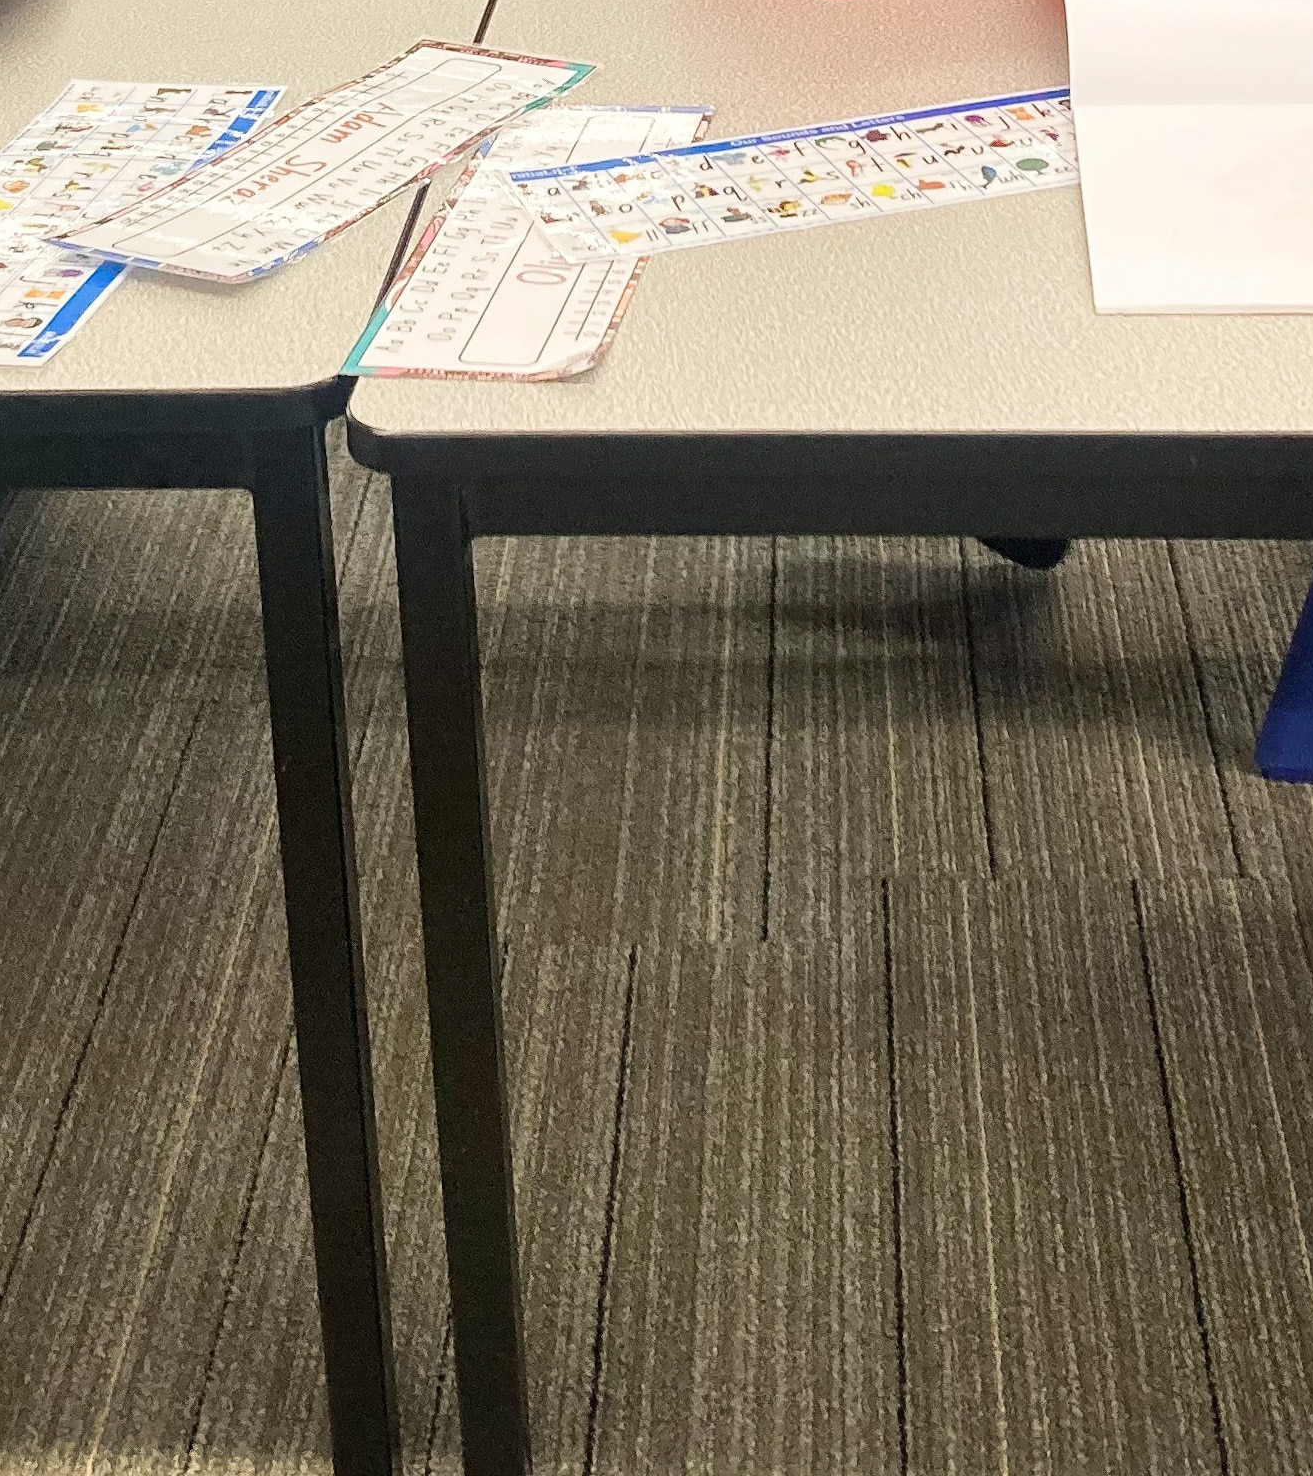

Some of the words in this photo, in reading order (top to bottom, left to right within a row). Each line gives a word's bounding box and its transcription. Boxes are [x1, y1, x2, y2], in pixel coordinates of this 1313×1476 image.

[319, 101, 404, 144] Adam
[761, 127, 825, 144] Sounds
[827, 123, 849, 133] and
[853, 114, 906, 129] Letters
[547, 185, 562, 197] a
[699, 154, 717, 172] d
[751, 152, 765, 165] e
[793, 140, 806, 157] f
[848, 138, 867, 155] g
[890, 125, 912, 142] h
[997, 115, 1011, 130] j
[1032, 103, 1055, 119] k
[219, 153, 328, 206] Sheraz
[618, 202, 633, 214] o
[671, 193, 687, 212] p
[722, 183, 748, 202] q
[774, 178, 786, 190] r
[826, 170, 839, 182] s
[922, 154, 940, 166] u
[970, 145, 985, 156] v
[852, 195, 872, 211] sh
[900, 188, 922, 202] ch
[998, 170, 1026, 185] wh
